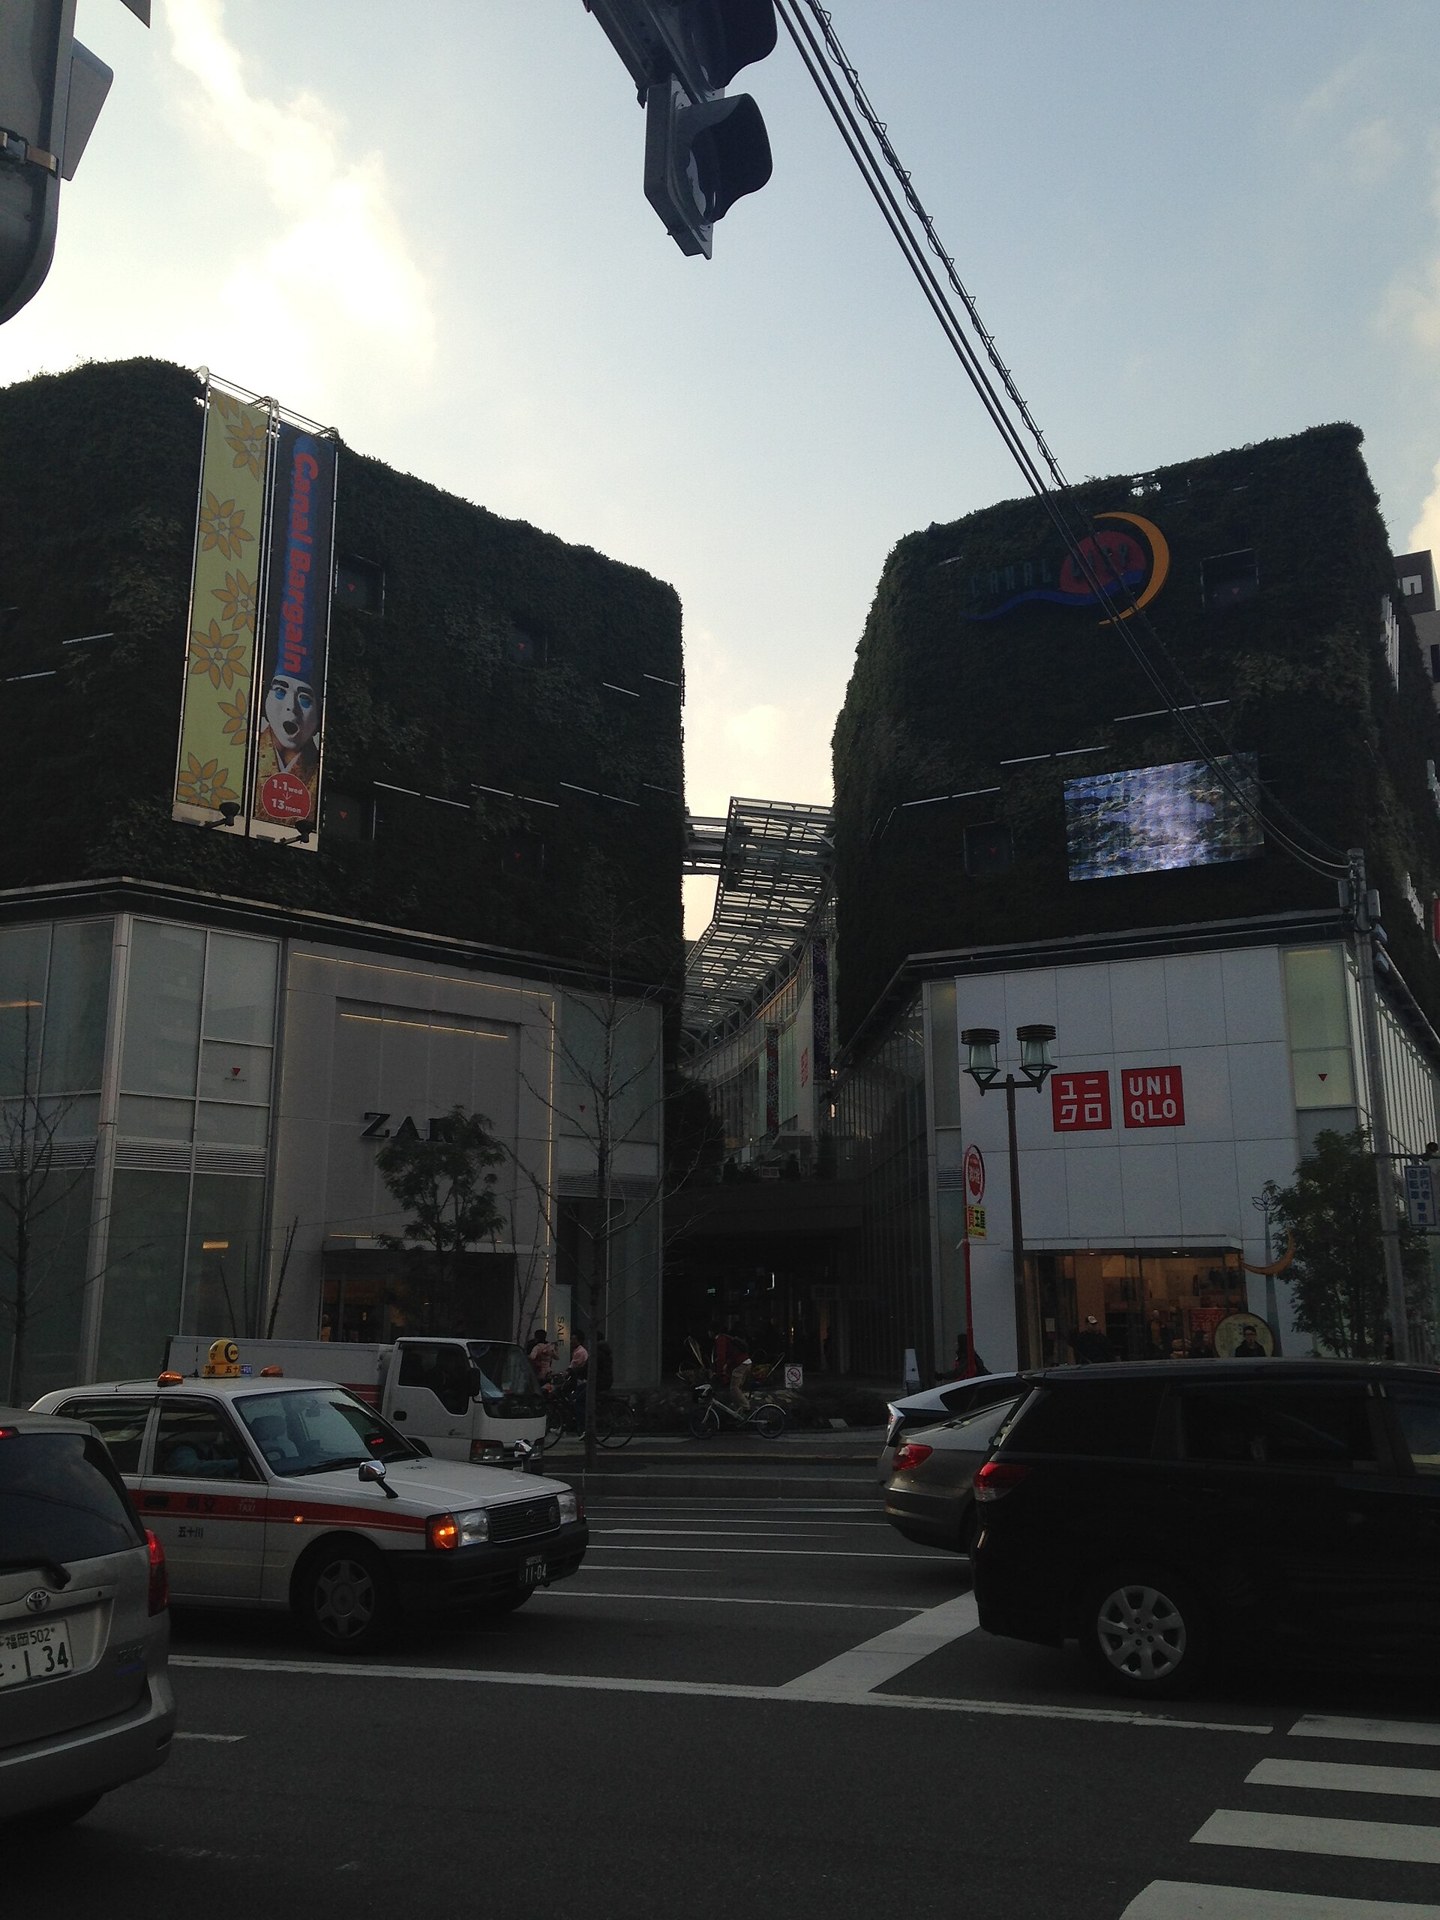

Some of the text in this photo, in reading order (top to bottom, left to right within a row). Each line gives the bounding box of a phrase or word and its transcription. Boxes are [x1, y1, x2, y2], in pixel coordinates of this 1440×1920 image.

[283, 452, 319, 673] Canal Bargain
[1060, 1079, 1102, 1100] ユニ
[1129, 1074, 1171, 1096] UNI
[1060, 1103, 1103, 1124] クロ
[1130, 1099, 1177, 1124] QLO
[178, 1526, 204, 1538] 五十川
